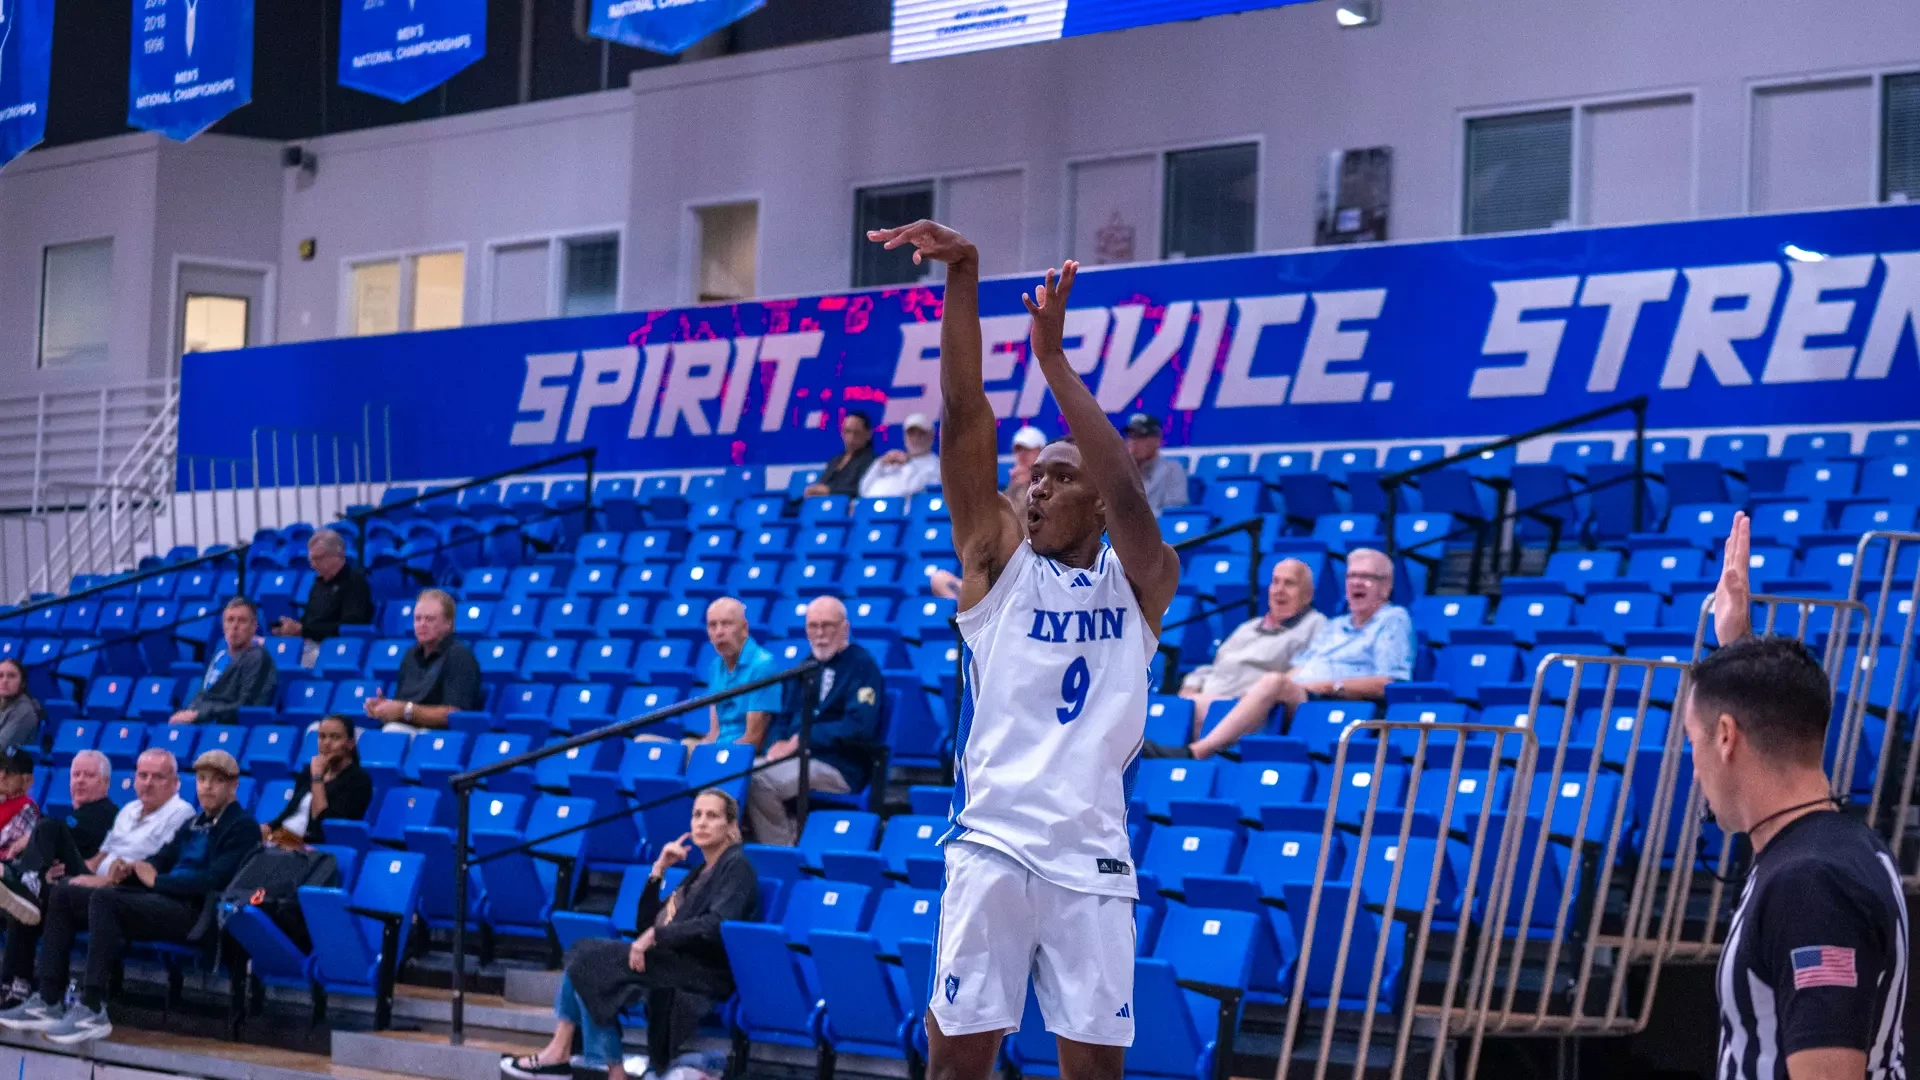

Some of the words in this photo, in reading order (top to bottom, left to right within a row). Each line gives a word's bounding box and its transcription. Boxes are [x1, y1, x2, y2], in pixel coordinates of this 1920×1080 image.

[352, 49, 394, 68] NATIONAL
[136, 91, 171, 109] NATIONAL
[509, 329, 825, 446] SPIRIT.
[880, 287, 1395, 426] SERVICE.
[1027, 607, 1128, 643] LYNN
[1055, 655, 1091, 725] 9
